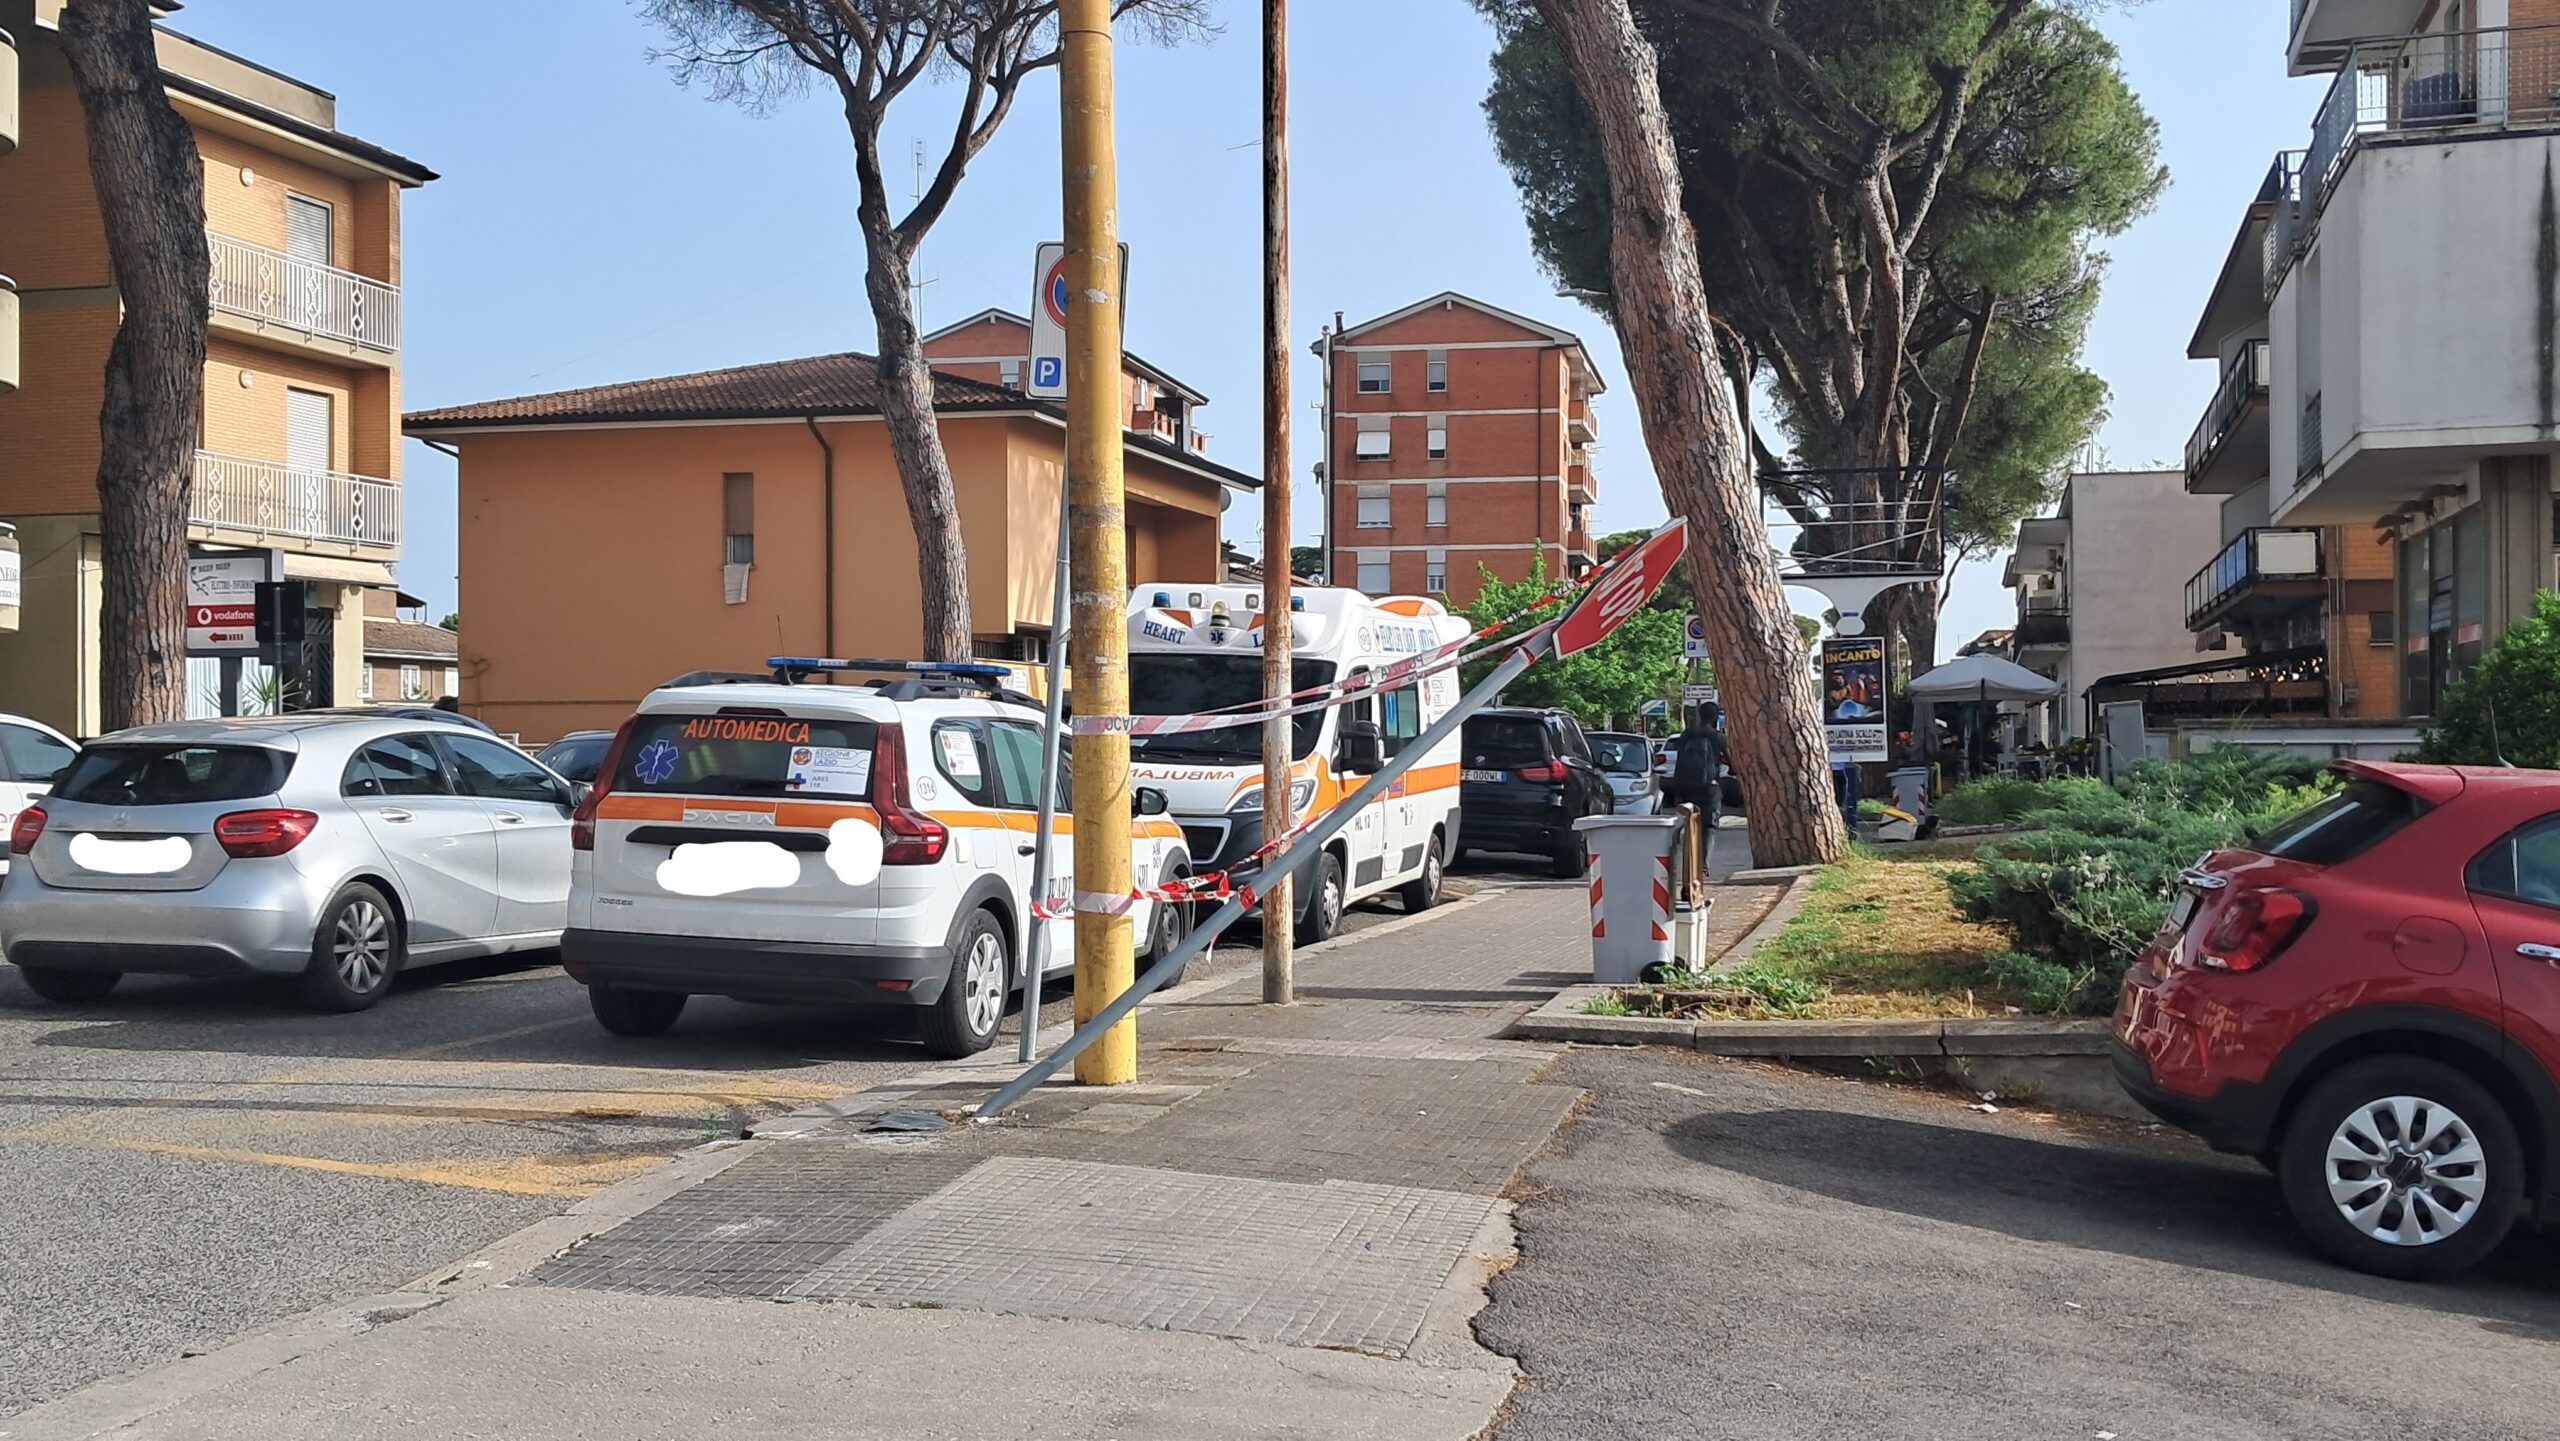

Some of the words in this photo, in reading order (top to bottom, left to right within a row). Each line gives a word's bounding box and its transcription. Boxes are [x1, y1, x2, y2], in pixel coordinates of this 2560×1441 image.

[1039, 360, 1056, 384] P
[1597, 549, 1646, 629] STOP
[213, 610, 255, 620] vodafone
[1143, 620, 1185, 645] HEART
[1826, 648, 1880, 663] INCANTO
[684, 718, 810, 744] AUTOMEDICA
[814, 758, 837, 766] LAZIO
[815, 750, 850, 759] REGIONE
[684, 811, 775, 826] DACIA
[597, 897, 633, 906] JOGGER
